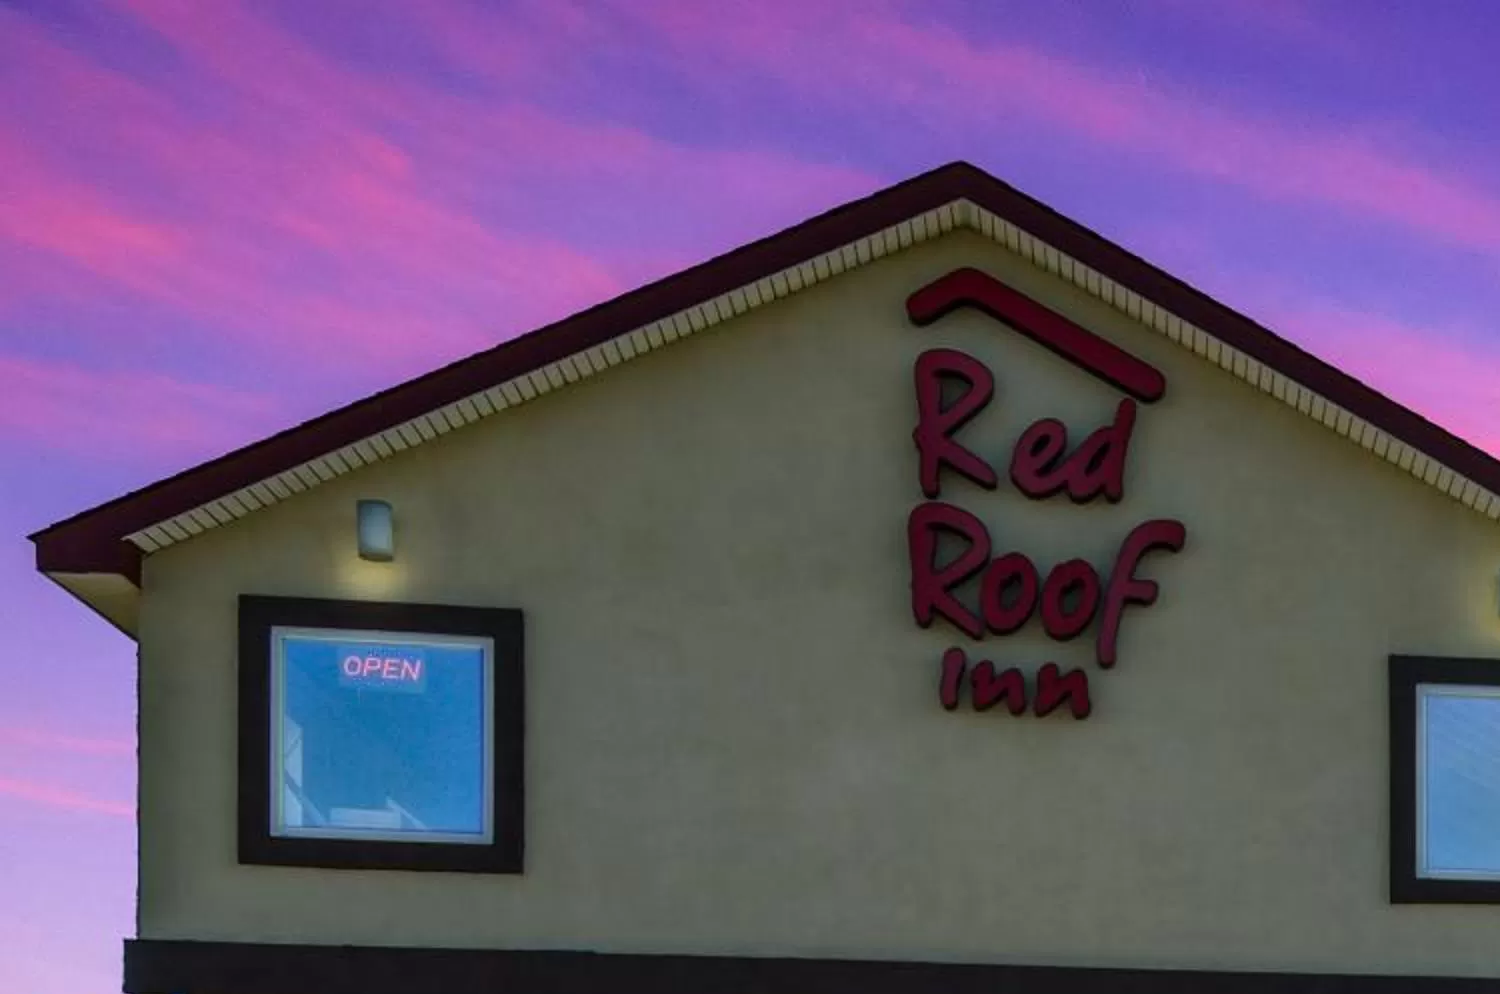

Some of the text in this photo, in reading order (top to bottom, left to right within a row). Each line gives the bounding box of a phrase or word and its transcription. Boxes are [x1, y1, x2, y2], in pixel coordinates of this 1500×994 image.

[913, 348, 1137, 503] Red
[907, 501, 1186, 668] Roof
[343, 655, 422, 681] OPEN
[940, 646, 1092, 719] Inn
